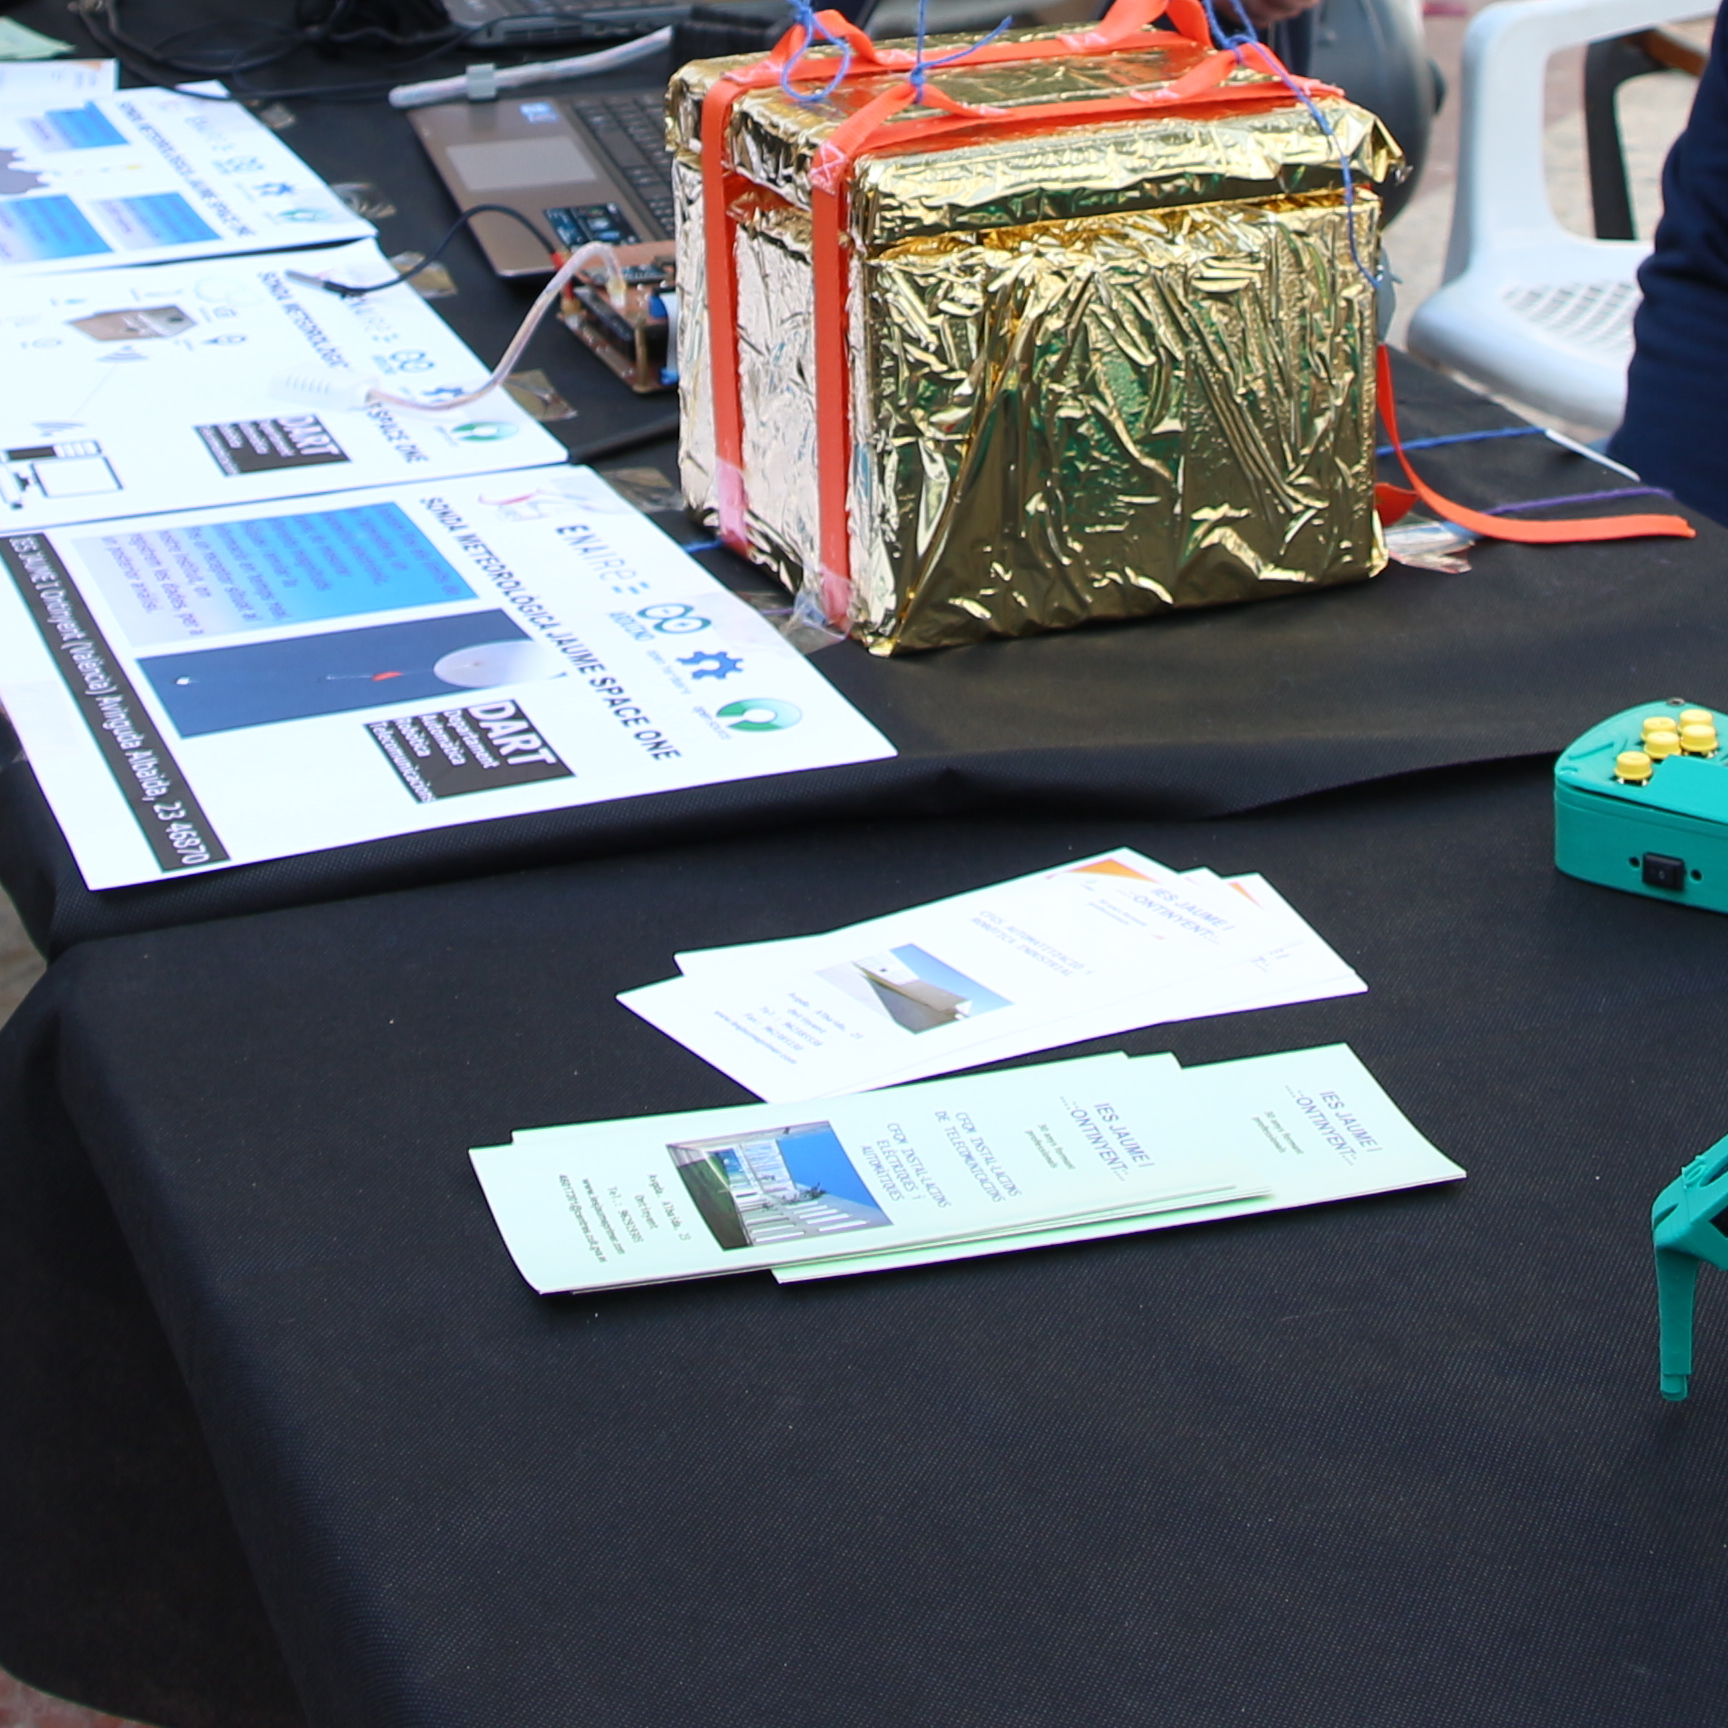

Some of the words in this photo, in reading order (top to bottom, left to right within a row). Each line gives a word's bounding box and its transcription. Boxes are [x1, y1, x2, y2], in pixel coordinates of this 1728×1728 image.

[274, 415, 341, 457] DART
[16, 551, 58, 583] JAUME
[30, 588, 91, 642] Ontinyent
[414, 495, 475, 533] SONDA
[540, 629, 611, 674] JAUME
[583, 675, 656, 727] SPACE
[629, 728, 687, 761] ONE
[57, 639, 121, 697] (València)
[87, 694, 149, 751] Avinguda
[414, 712, 475, 766] Automàtica
[435, 708, 506, 770] Departament
[462, 700, 561, 770] DART
[117, 748, 177, 802] Albaida,
[363, 720, 444, 804] Telecomunicacions
[150, 800, 187, 822] 23
[160, 819, 212, 866] 46870
[1147, 887, 1183, 902] IES
[1170, 899, 1231, 927] JAUME
[930, 1109, 955, 1123] DE
[1091, 1102, 1123, 1122] IES
[1317, 1090, 1347, 1109] IES
[1332, 1109, 1379, 1148] JAUME
[940, 1125, 1010, 1203] TELECOMUNICACIONS
[1105, 1123, 1153, 1162] JAUME
[856, 1143, 908, 1202] AUTOMÀTIQUES
